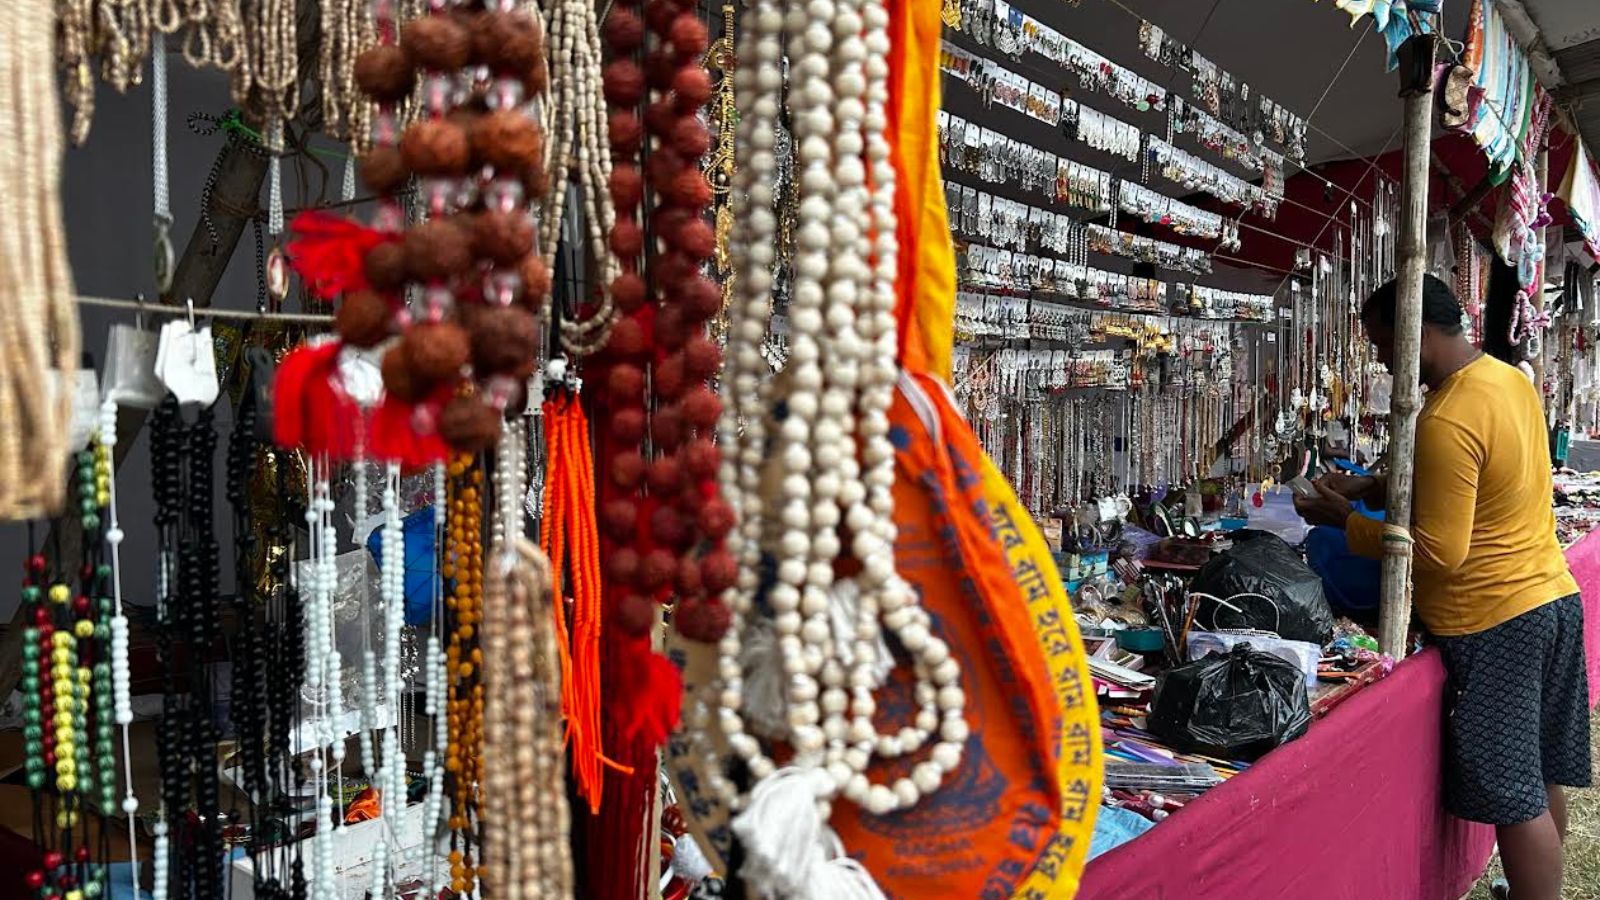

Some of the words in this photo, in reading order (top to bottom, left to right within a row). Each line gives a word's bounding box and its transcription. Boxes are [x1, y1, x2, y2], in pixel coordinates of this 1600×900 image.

[1056, 663, 1085, 709] রাম
[1065, 719, 1092, 767] রাম
[1062, 778, 1091, 822] রাম
